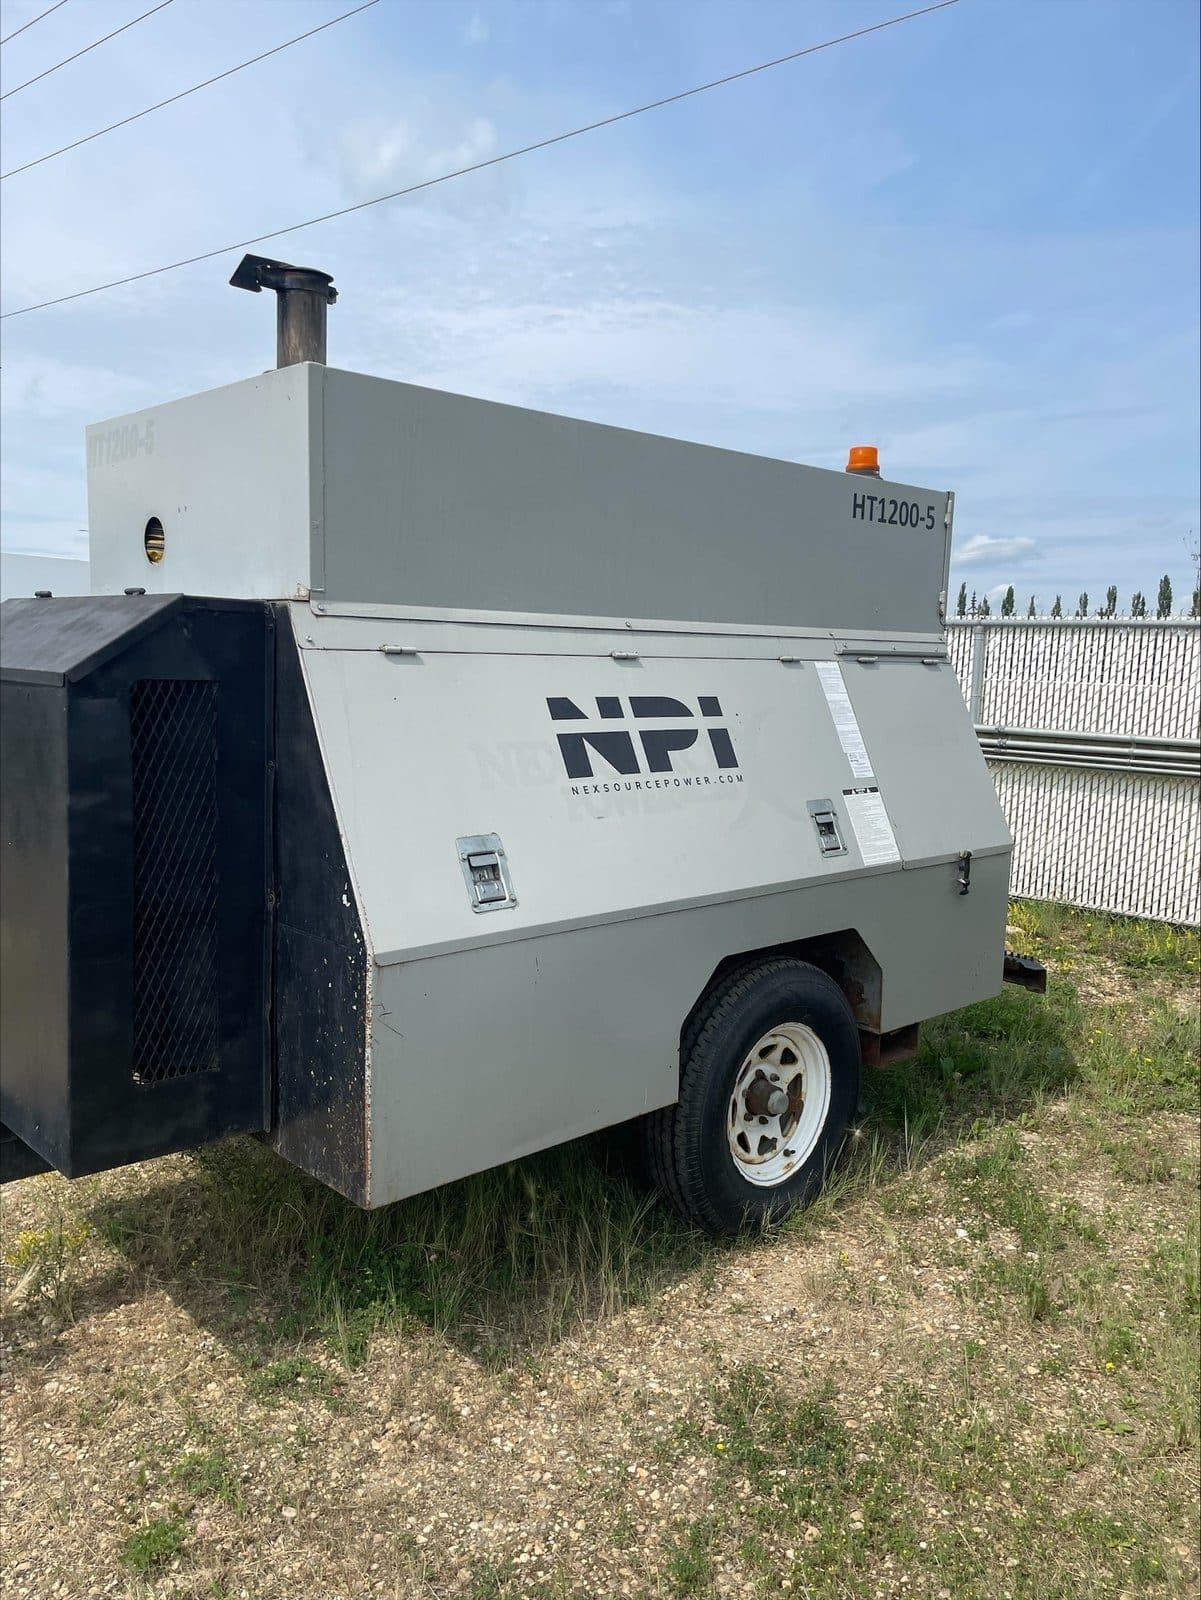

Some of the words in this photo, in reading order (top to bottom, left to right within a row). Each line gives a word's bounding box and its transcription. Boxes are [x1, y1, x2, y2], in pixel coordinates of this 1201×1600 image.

[852, 493, 935, 530] HT1200-5
[546, 696, 739, 779] NPI
[571, 774, 744, 796] NEXSOURCEPOWER.COM
